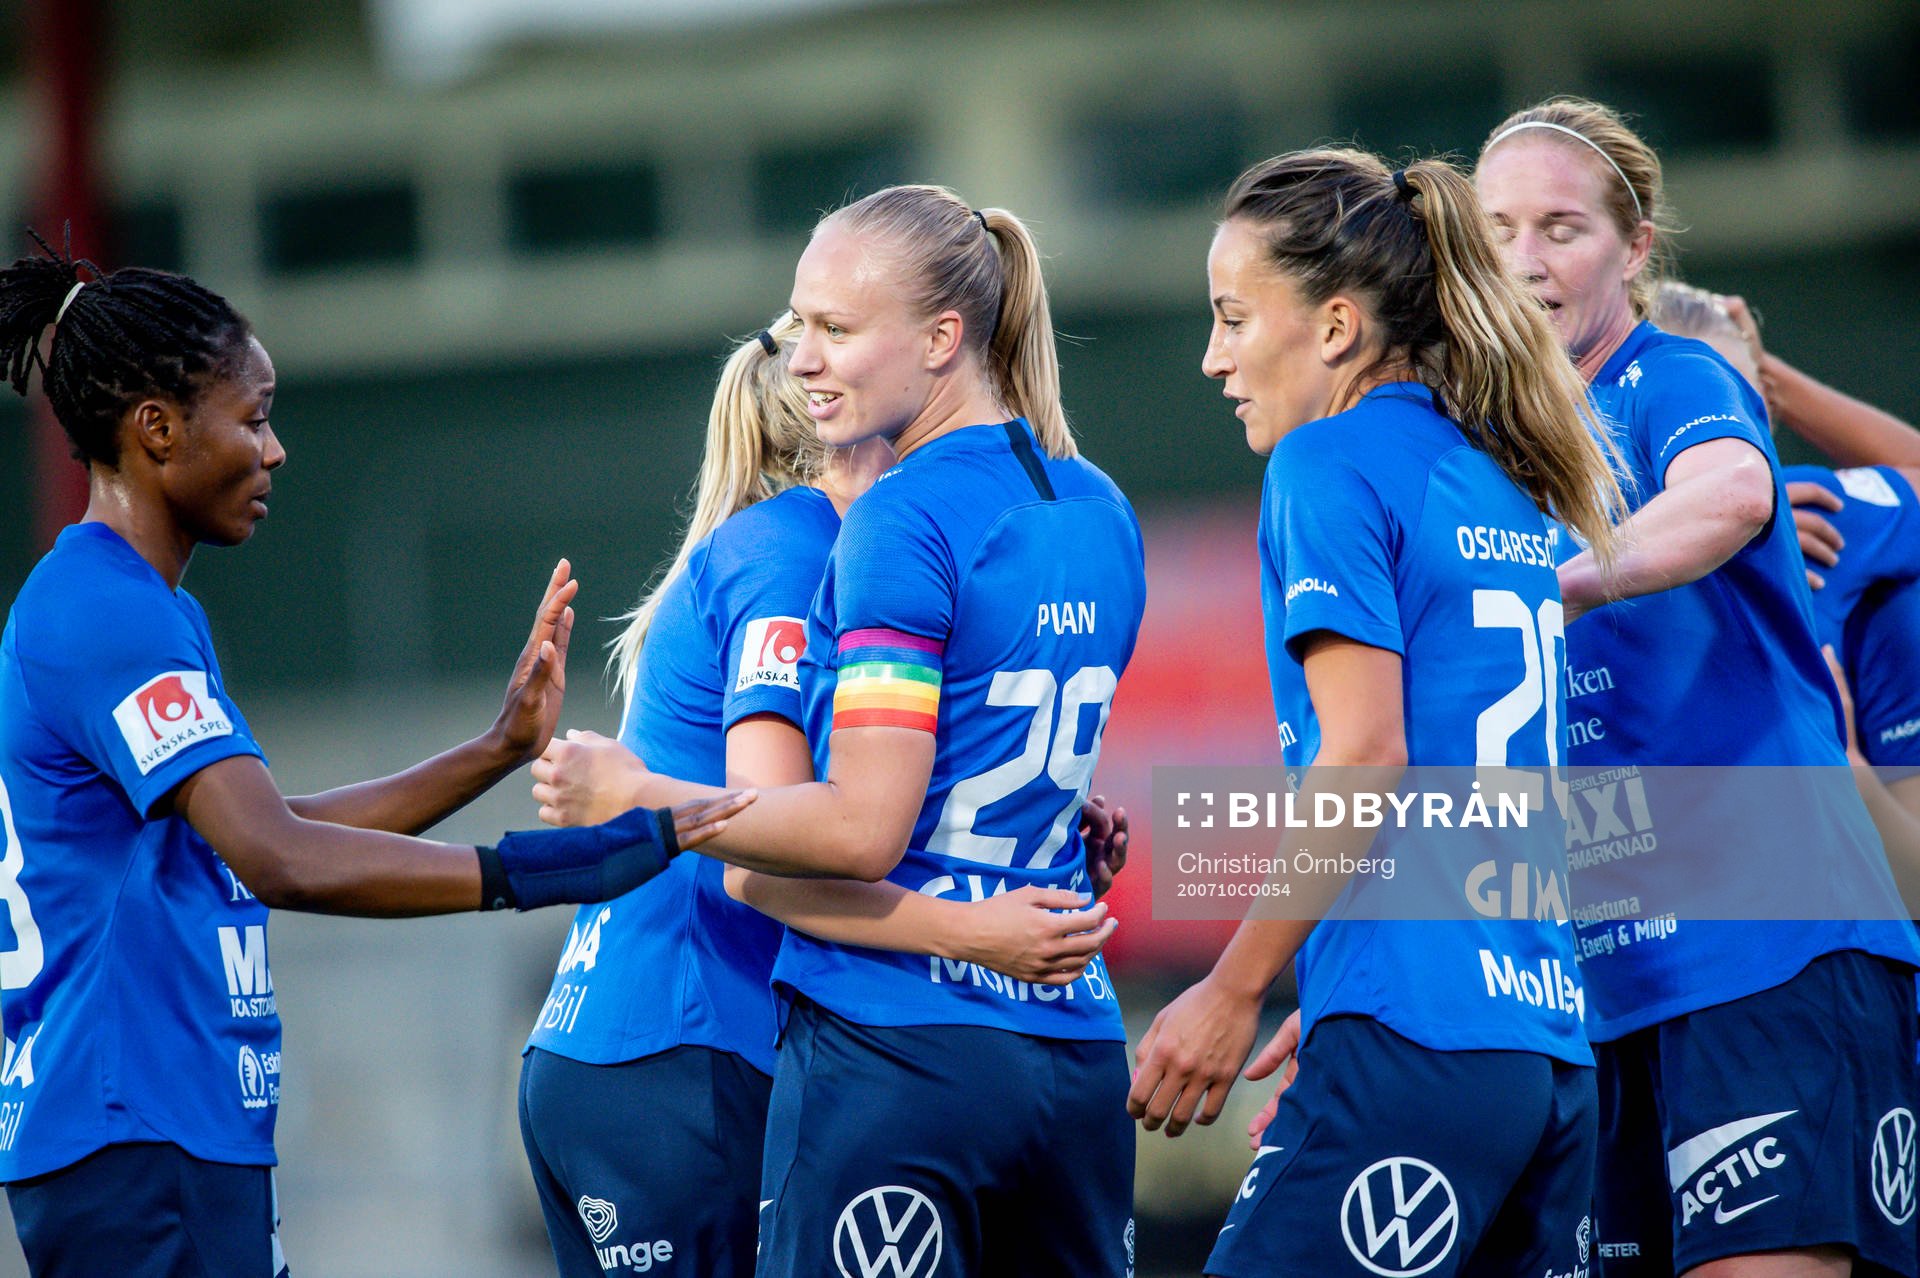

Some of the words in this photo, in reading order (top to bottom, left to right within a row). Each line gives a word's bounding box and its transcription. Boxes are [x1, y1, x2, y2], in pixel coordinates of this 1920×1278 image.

[1456, 526, 1555, 570] OSCARSSO
[1285, 577, 1339, 606] GNOLIA
[141, 728, 197, 767] SVENSKA
[199, 720, 230, 734] SPEL
[924, 665, 1118, 869] 29
[1570, 765, 1640, 792] ESKILSTUNA
[1566, 776, 1654, 850] AXI
[1567, 832, 1658, 872] RMARKNAD
[1465, 860, 1569, 926] GIM
[1572, 896, 1641, 930] Eskilstuna
[1581, 928, 1616, 958] Energi
[1618, 925, 1631, 946] &
[1634, 912, 1678, 942] Miljö
[1683, 1137, 1786, 1226] ACTIC
[594, 1240, 673, 1273] unge
[1598, 1242, 1640, 1257] HETER
